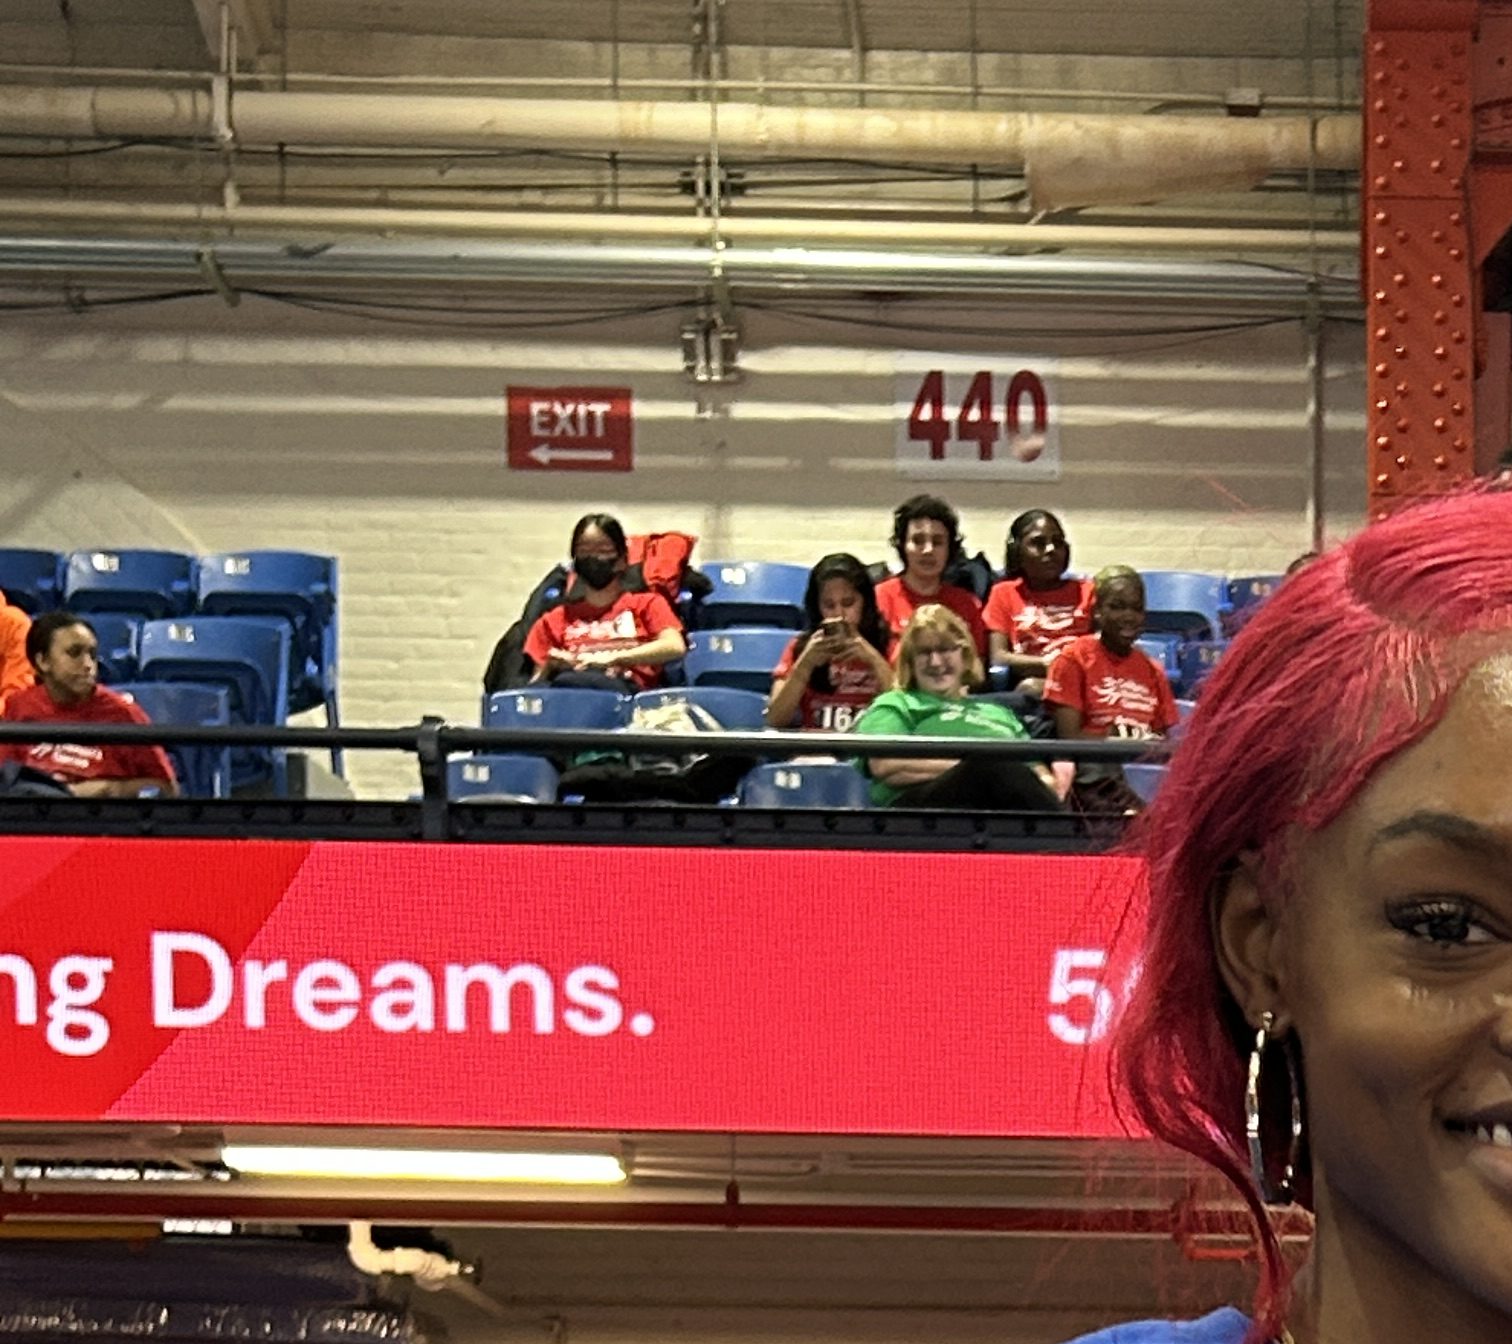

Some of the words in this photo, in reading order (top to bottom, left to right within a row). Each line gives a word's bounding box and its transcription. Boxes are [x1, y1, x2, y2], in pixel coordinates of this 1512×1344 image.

[529, 401, 612, 438] EXIT
[909, 369, 1047, 462] 440
[150, 931, 656, 1037] Dreams.
[1047, 948, 1144, 1045] 5
